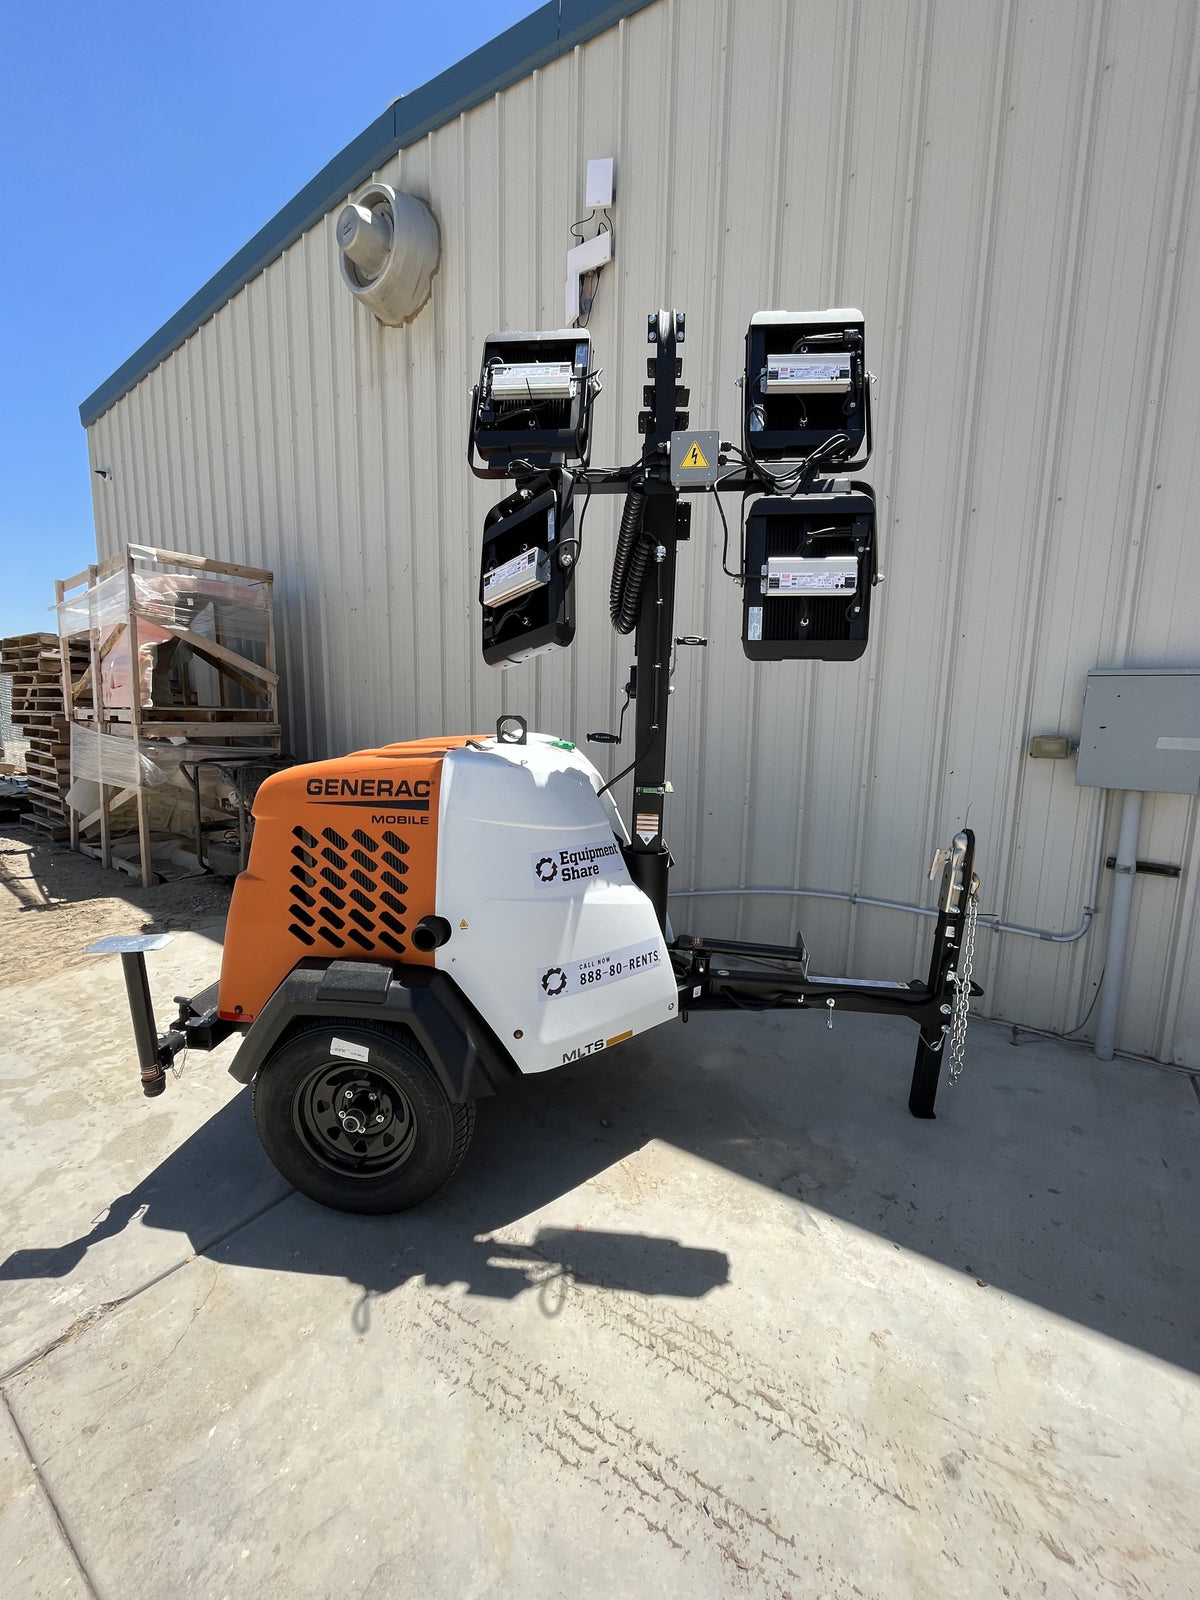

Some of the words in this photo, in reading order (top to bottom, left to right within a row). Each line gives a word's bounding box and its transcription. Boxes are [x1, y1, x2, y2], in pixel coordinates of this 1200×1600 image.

[305, 778, 431, 797] GENERAC
[371, 815, 429, 825] MOBILE
[559, 843, 619, 866] Equipment
[561, 864, 600, 882] Share
[579, 961, 595, 970] CALL
[597, 956, 611, 966] NOW
[579, 950, 659, 985] 888-80-RENTS
[562, 1038, 604, 1064] MLTS
